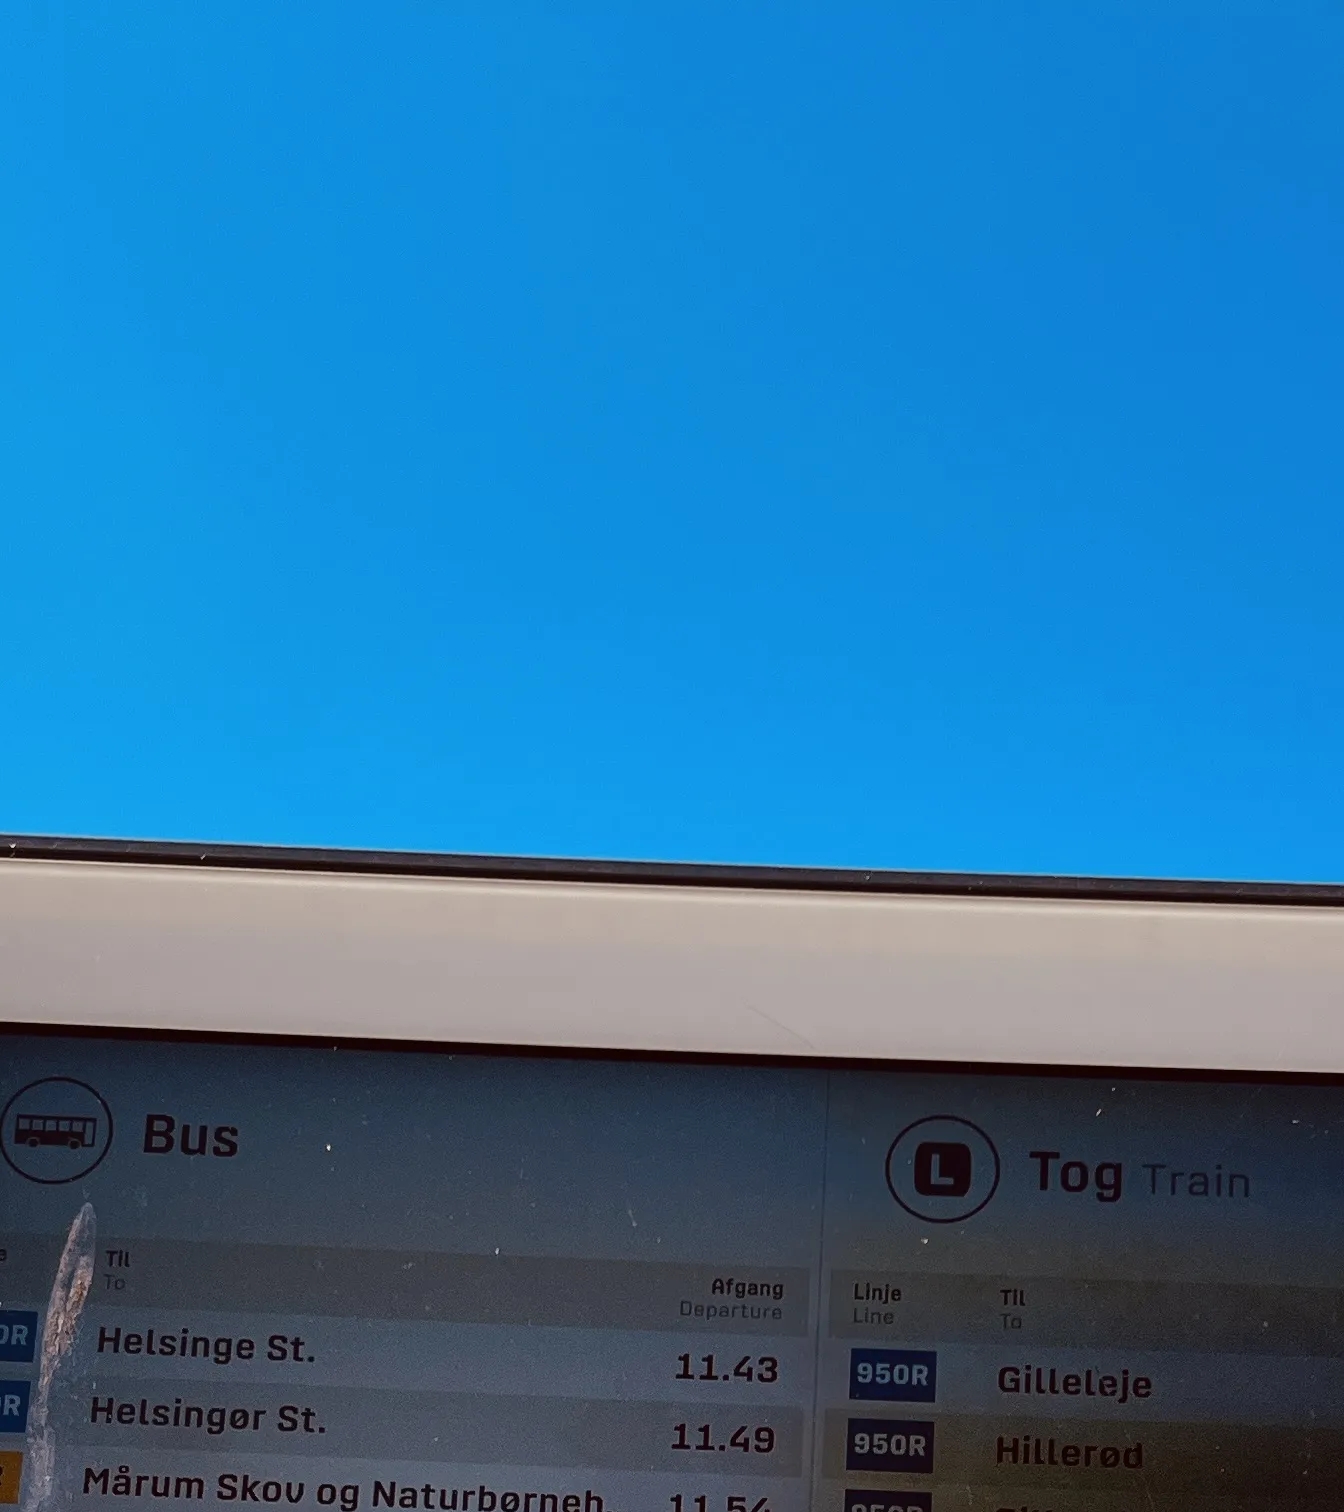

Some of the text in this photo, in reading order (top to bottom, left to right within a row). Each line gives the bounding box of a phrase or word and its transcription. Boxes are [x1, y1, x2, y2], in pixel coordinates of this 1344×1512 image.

[143, 1114, 239, 1157] Bus
[1029, 1150, 1251, 1203] Tog Train
[105, 1249, 131, 1268] Til
[103, 1273, 126, 1291] To
[711, 1278, 785, 1300] Afgang
[853, 1283, 902, 1304] Linje
[999, 1288, 1026, 1307] Til
[679, 1301, 784, 1321] Departure
[852, 1308, 895, 1326] Line
[999, 1312, 1023, 1330] To
[96, 1327, 316, 1365] Helsinge St.
[674, 1353, 780, 1384] 11.43
[857, 1363, 929, 1387] 950R
[997, 1364, 1153, 1404] Gilleleje
[90, 1396, 327, 1435] Helsingør St.
[670, 1424, 775, 1455] 11.49
[854, 1433, 927, 1456] 950R
[995, 1435, 1144, 1469] Hillerød
[83, 1466, 206, 1500] Mårum
[215, 1473, 306, 1504] Skov
[316, 1483, 360, 1512] og
